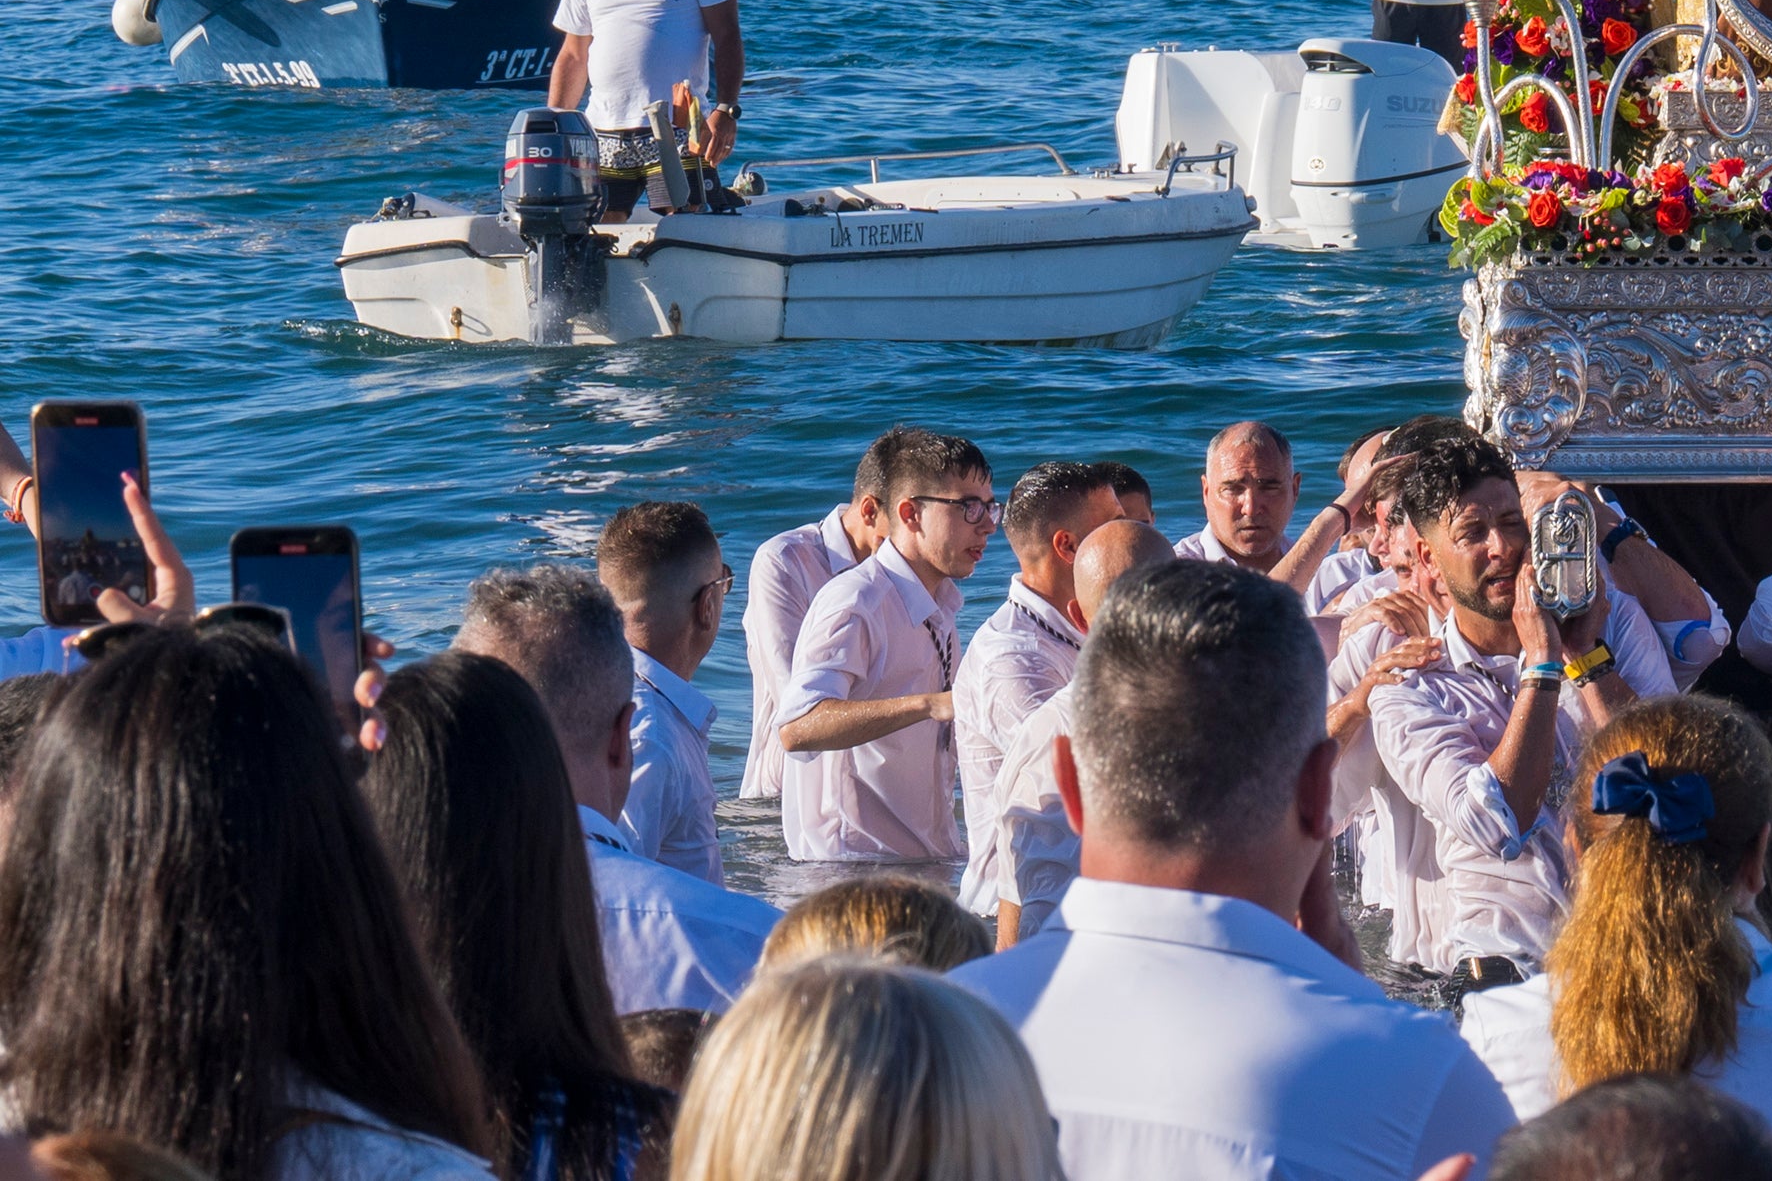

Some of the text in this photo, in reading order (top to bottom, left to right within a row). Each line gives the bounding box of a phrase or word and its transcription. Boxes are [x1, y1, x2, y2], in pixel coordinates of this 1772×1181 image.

[1387, 94, 1443, 115] SUZU
[528, 147, 553, 158] 30
[830, 222, 924, 248] LA TREMEN
